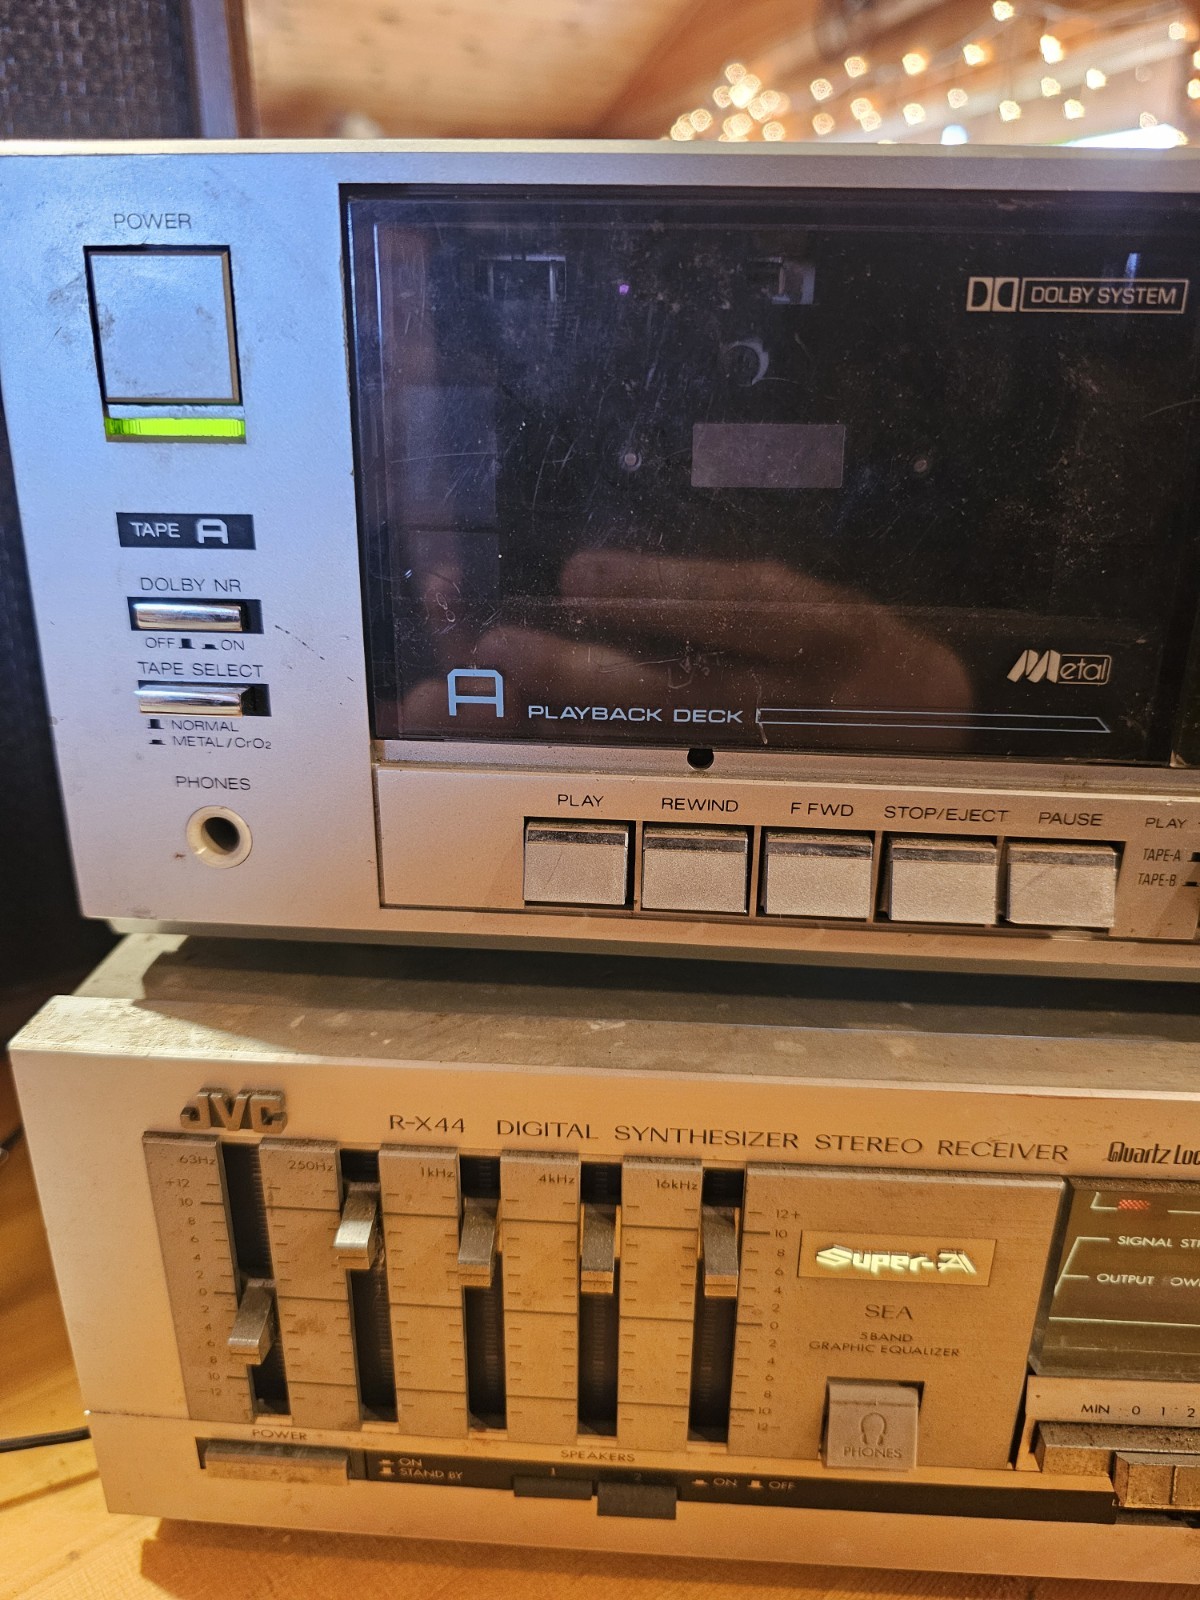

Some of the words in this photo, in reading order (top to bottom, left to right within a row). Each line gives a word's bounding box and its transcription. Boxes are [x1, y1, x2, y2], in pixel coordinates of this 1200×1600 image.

[113, 213, 192, 230] POWER
[1031, 286, 1094, 304] DOLBY
[1097, 286, 1177, 305] SYSTEM
[129, 522, 181, 538] TAPE
[196, 518, 229, 545] A
[140, 577, 206, 592] DOLBY
[214, 579, 242, 593] NR
[145, 637, 175, 649] OFF
[220, 639, 245, 651] ON
[138, 661, 184, 676] TAPE
[192, 663, 264, 678] SELECT
[1006, 649, 1107, 684] Metal
[447, 668, 504, 718] A
[528, 705, 663, 722] PLAYBACK
[673, 708, 743, 724] DECK
[171, 720, 240, 732] NORMAL
[175, 775, 251, 791] PHONES
[557, 794, 604, 807] PLAY
[661, 797, 739, 813] REWIND
[807, 803, 854, 817] FWD
[884, 806, 1009, 823] STOP/EJECT
[1038, 811, 1103, 827] PAUSE
[1145, 817, 1187, 829] PLAY
[1143, 848, 1182, 862] TAPE-A
[1137, 873, 1177, 887] TAPE-B
[180, 1088, 289, 1134] JVC
[389, 1114, 465, 1134] R-X44
[497, 1120, 599, 1140] DIGITAL
[614, 1125, 799, 1150] SYNTHESIZER
[814, 1133, 923, 1155] STEREO
[937, 1140, 1069, 1161] RECEIVER
[1107, 1141, 1171, 1164] Quartz
[179, 1154, 216, 1166] 63Hz
[288, 1160, 334, 1172] 250Hz
[420, 1167, 455, 1179] 1kHz
[538, 1174, 575, 1185] 4kHz
[656, 1178, 698, 1191] 16kHz
[180, 1198, 193, 1207] 10
[188, 1217, 196, 1225] 8
[191, 1235, 199, 1243] 6
[775, 1229, 787, 1238] 10
[1117, 1235, 1173, 1248] SIGNAL
[193, 1253, 200, 1261] 4
[777, 1249, 785, 1257] 8
[196, 1271, 204, 1279] 2
[775, 1267, 784, 1276] 6
[1096, 1273, 1155, 1285] OUTPUT
[200, 1288, 208, 1296] 0
[773, 1286, 782, 1295] 4
[201, 1305, 209, 1313] 2
[771, 1303, 780, 1313] 2
[864, 1304, 913, 1320] SEA
[769, 1321, 779, 1330] 0
[207, 1339, 215, 1347] 6
[768, 1339, 777, 1348] 2
[809, 1340, 876, 1353] GRAPHIC
[881, 1344, 960, 1357] EQUALIZER
[767, 1357, 775, 1366] 4
[207, 1373, 220, 1381] 10
[765, 1373, 774, 1382] 6
[763, 1390, 772, 1399] 8
[758, 1407, 771, 1415] 10
[1080, 1404, 1110, 1415] MIN
[1131, 1405, 1141, 1415] 0
[1161, 1407, 1166, 1417] 1
[1187, 1408, 1196, 1418] 2
[252, 1429, 308, 1441] POWER
[561, 1450, 636, 1463] SPEAKERS
[843, 1447, 903, 1459] PHONES
[399, 1457, 423, 1467] ON
[399, 1467, 445, 1479] STAND
[447, 1471, 464, 1480] BY
[713, 1477, 738, 1488] ON
[769, 1480, 797, 1490] OFF
